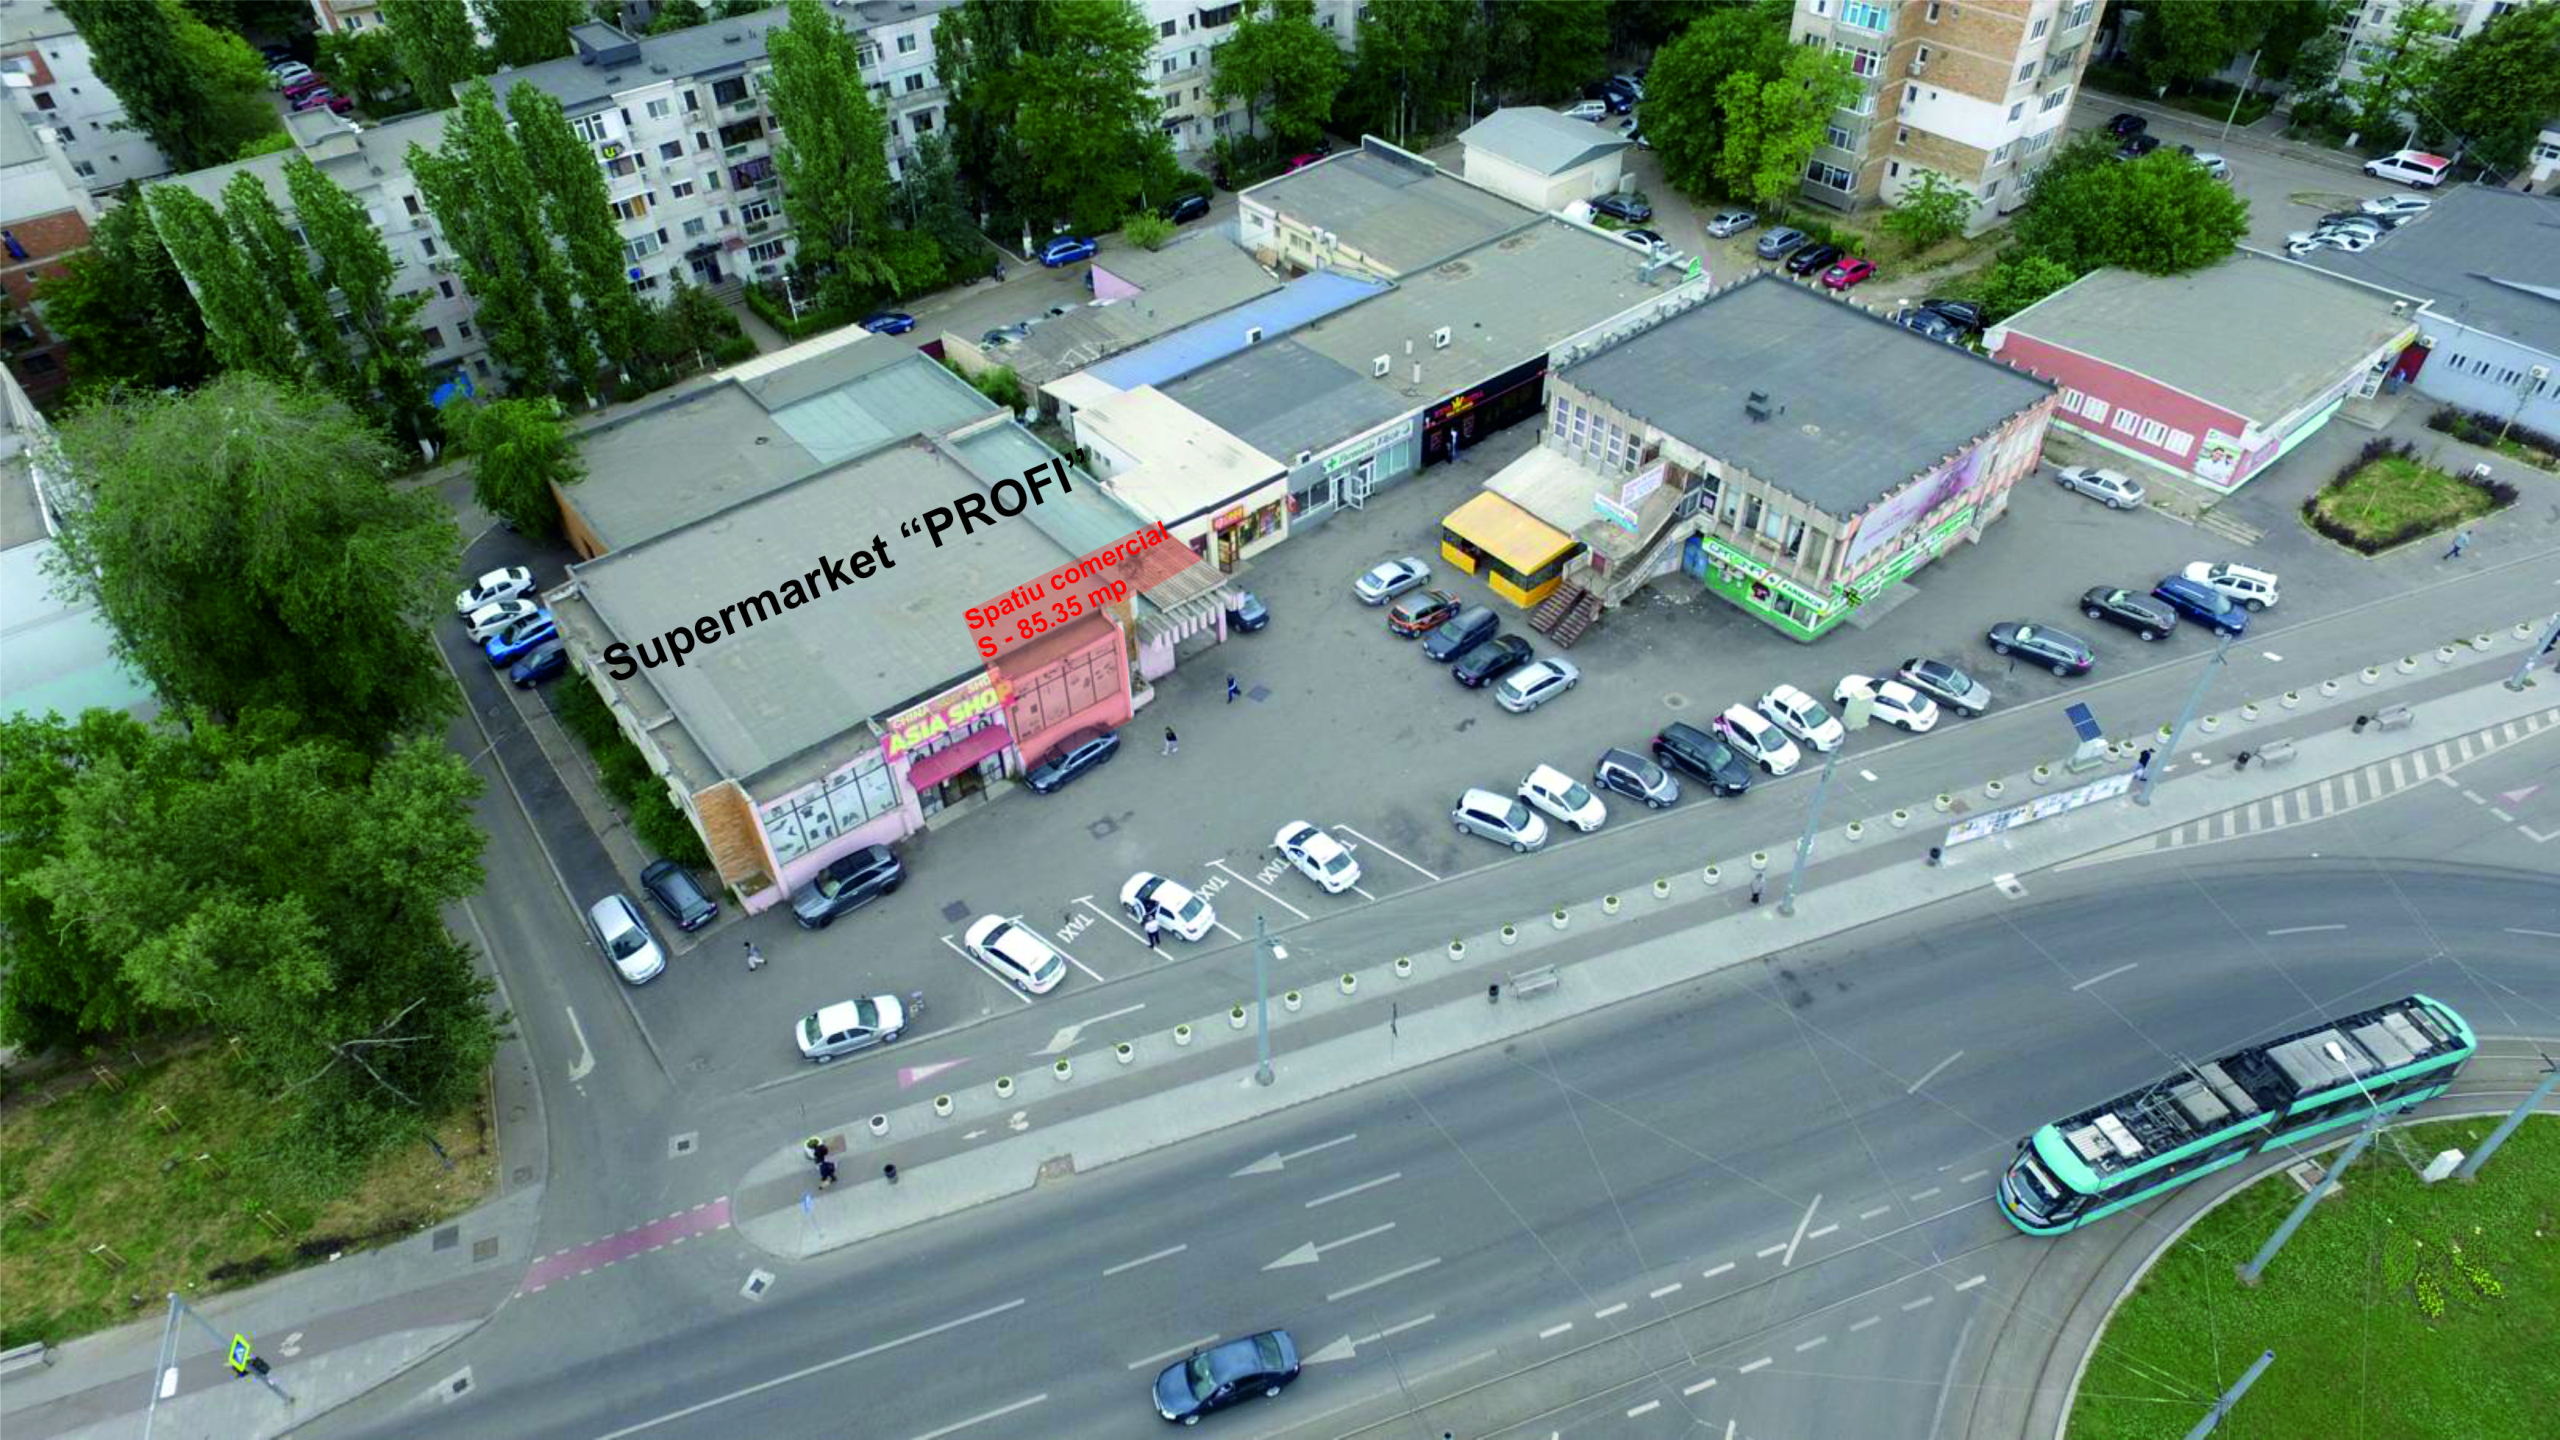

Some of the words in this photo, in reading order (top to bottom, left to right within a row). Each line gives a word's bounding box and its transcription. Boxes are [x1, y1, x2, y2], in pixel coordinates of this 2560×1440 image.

[887, 714, 949, 756] ASIA
[946, 682, 1014, 724] SHOP
[1056, 913, 1095, 944] TAXI
